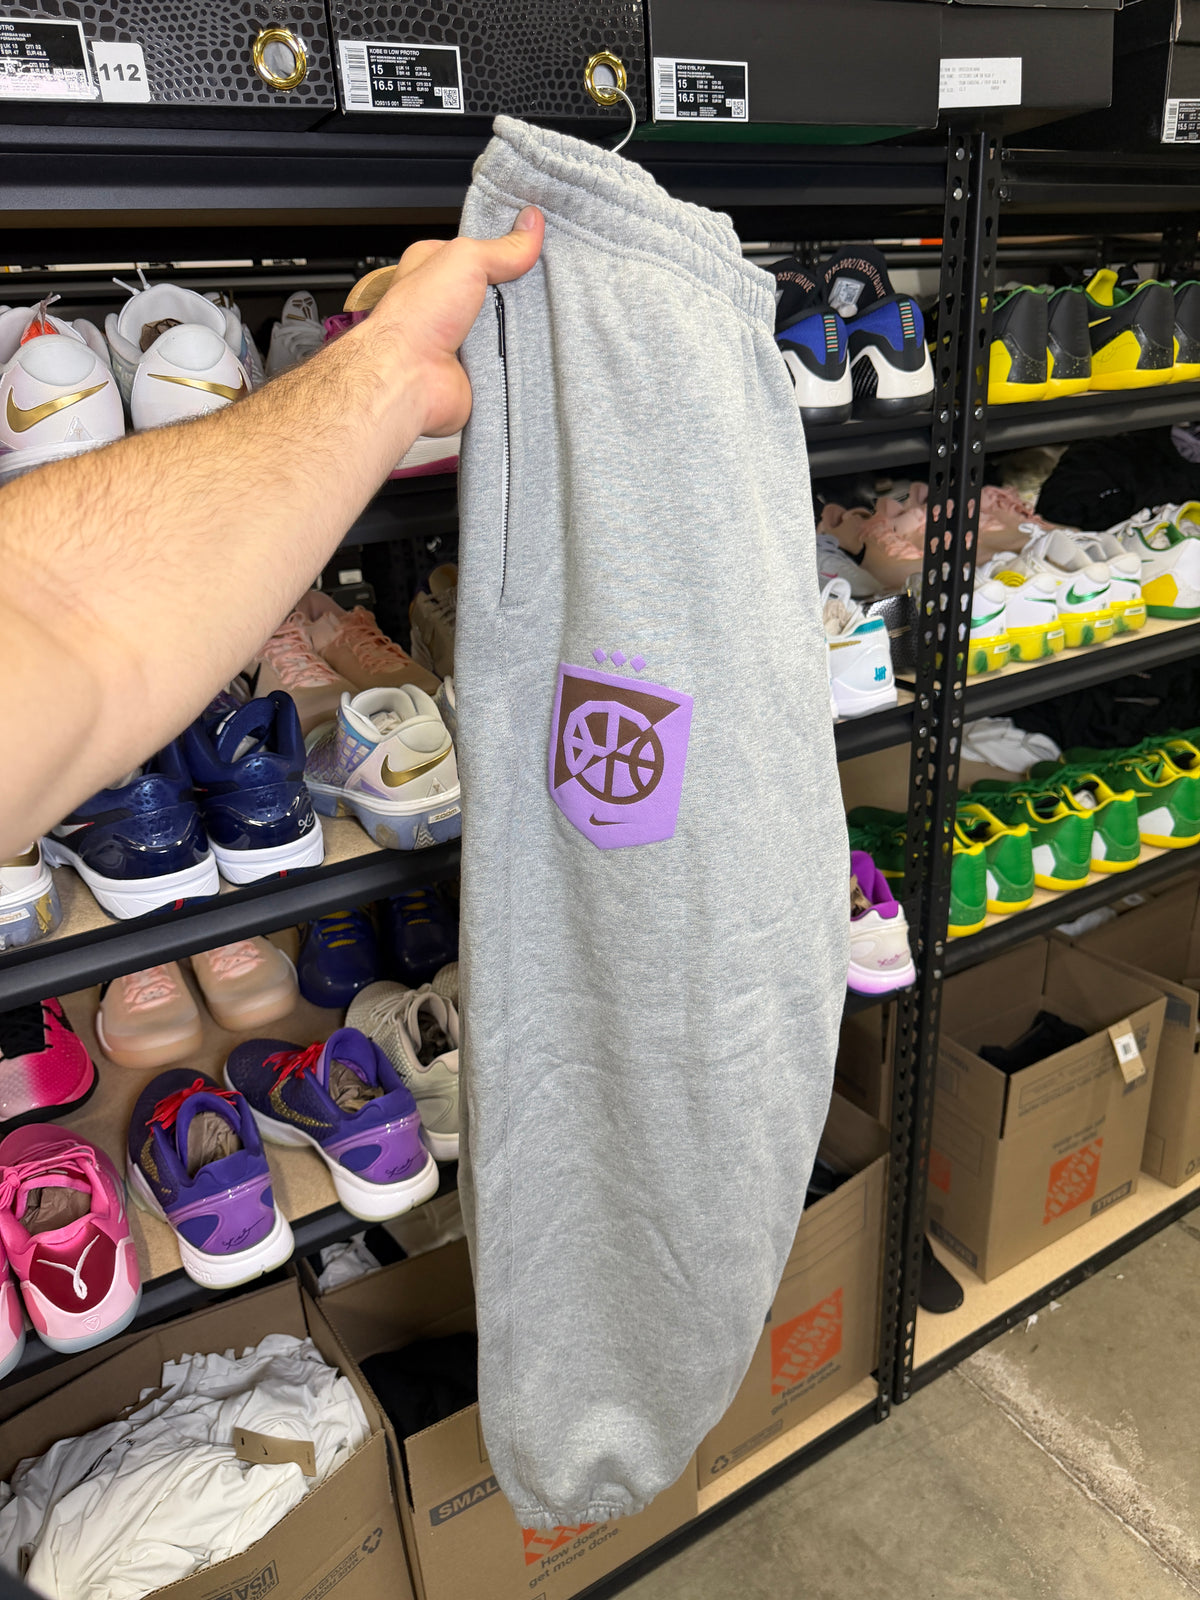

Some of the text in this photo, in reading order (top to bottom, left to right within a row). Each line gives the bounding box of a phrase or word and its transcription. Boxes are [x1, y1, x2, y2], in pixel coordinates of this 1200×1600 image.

[99, 64, 141, 82] 112
[371, 64, 384, 75] 15
[372, 80, 394, 91] 16.5
[677, 79, 688, 89] 15
[677, 93, 695, 103] 16.5
[438, 1480, 498, 1519] SMAL
[541, 1524, 608, 1569] How doers
[528, 1528, 619, 1589] get more done
[234, 1566, 274, 1600] USA
